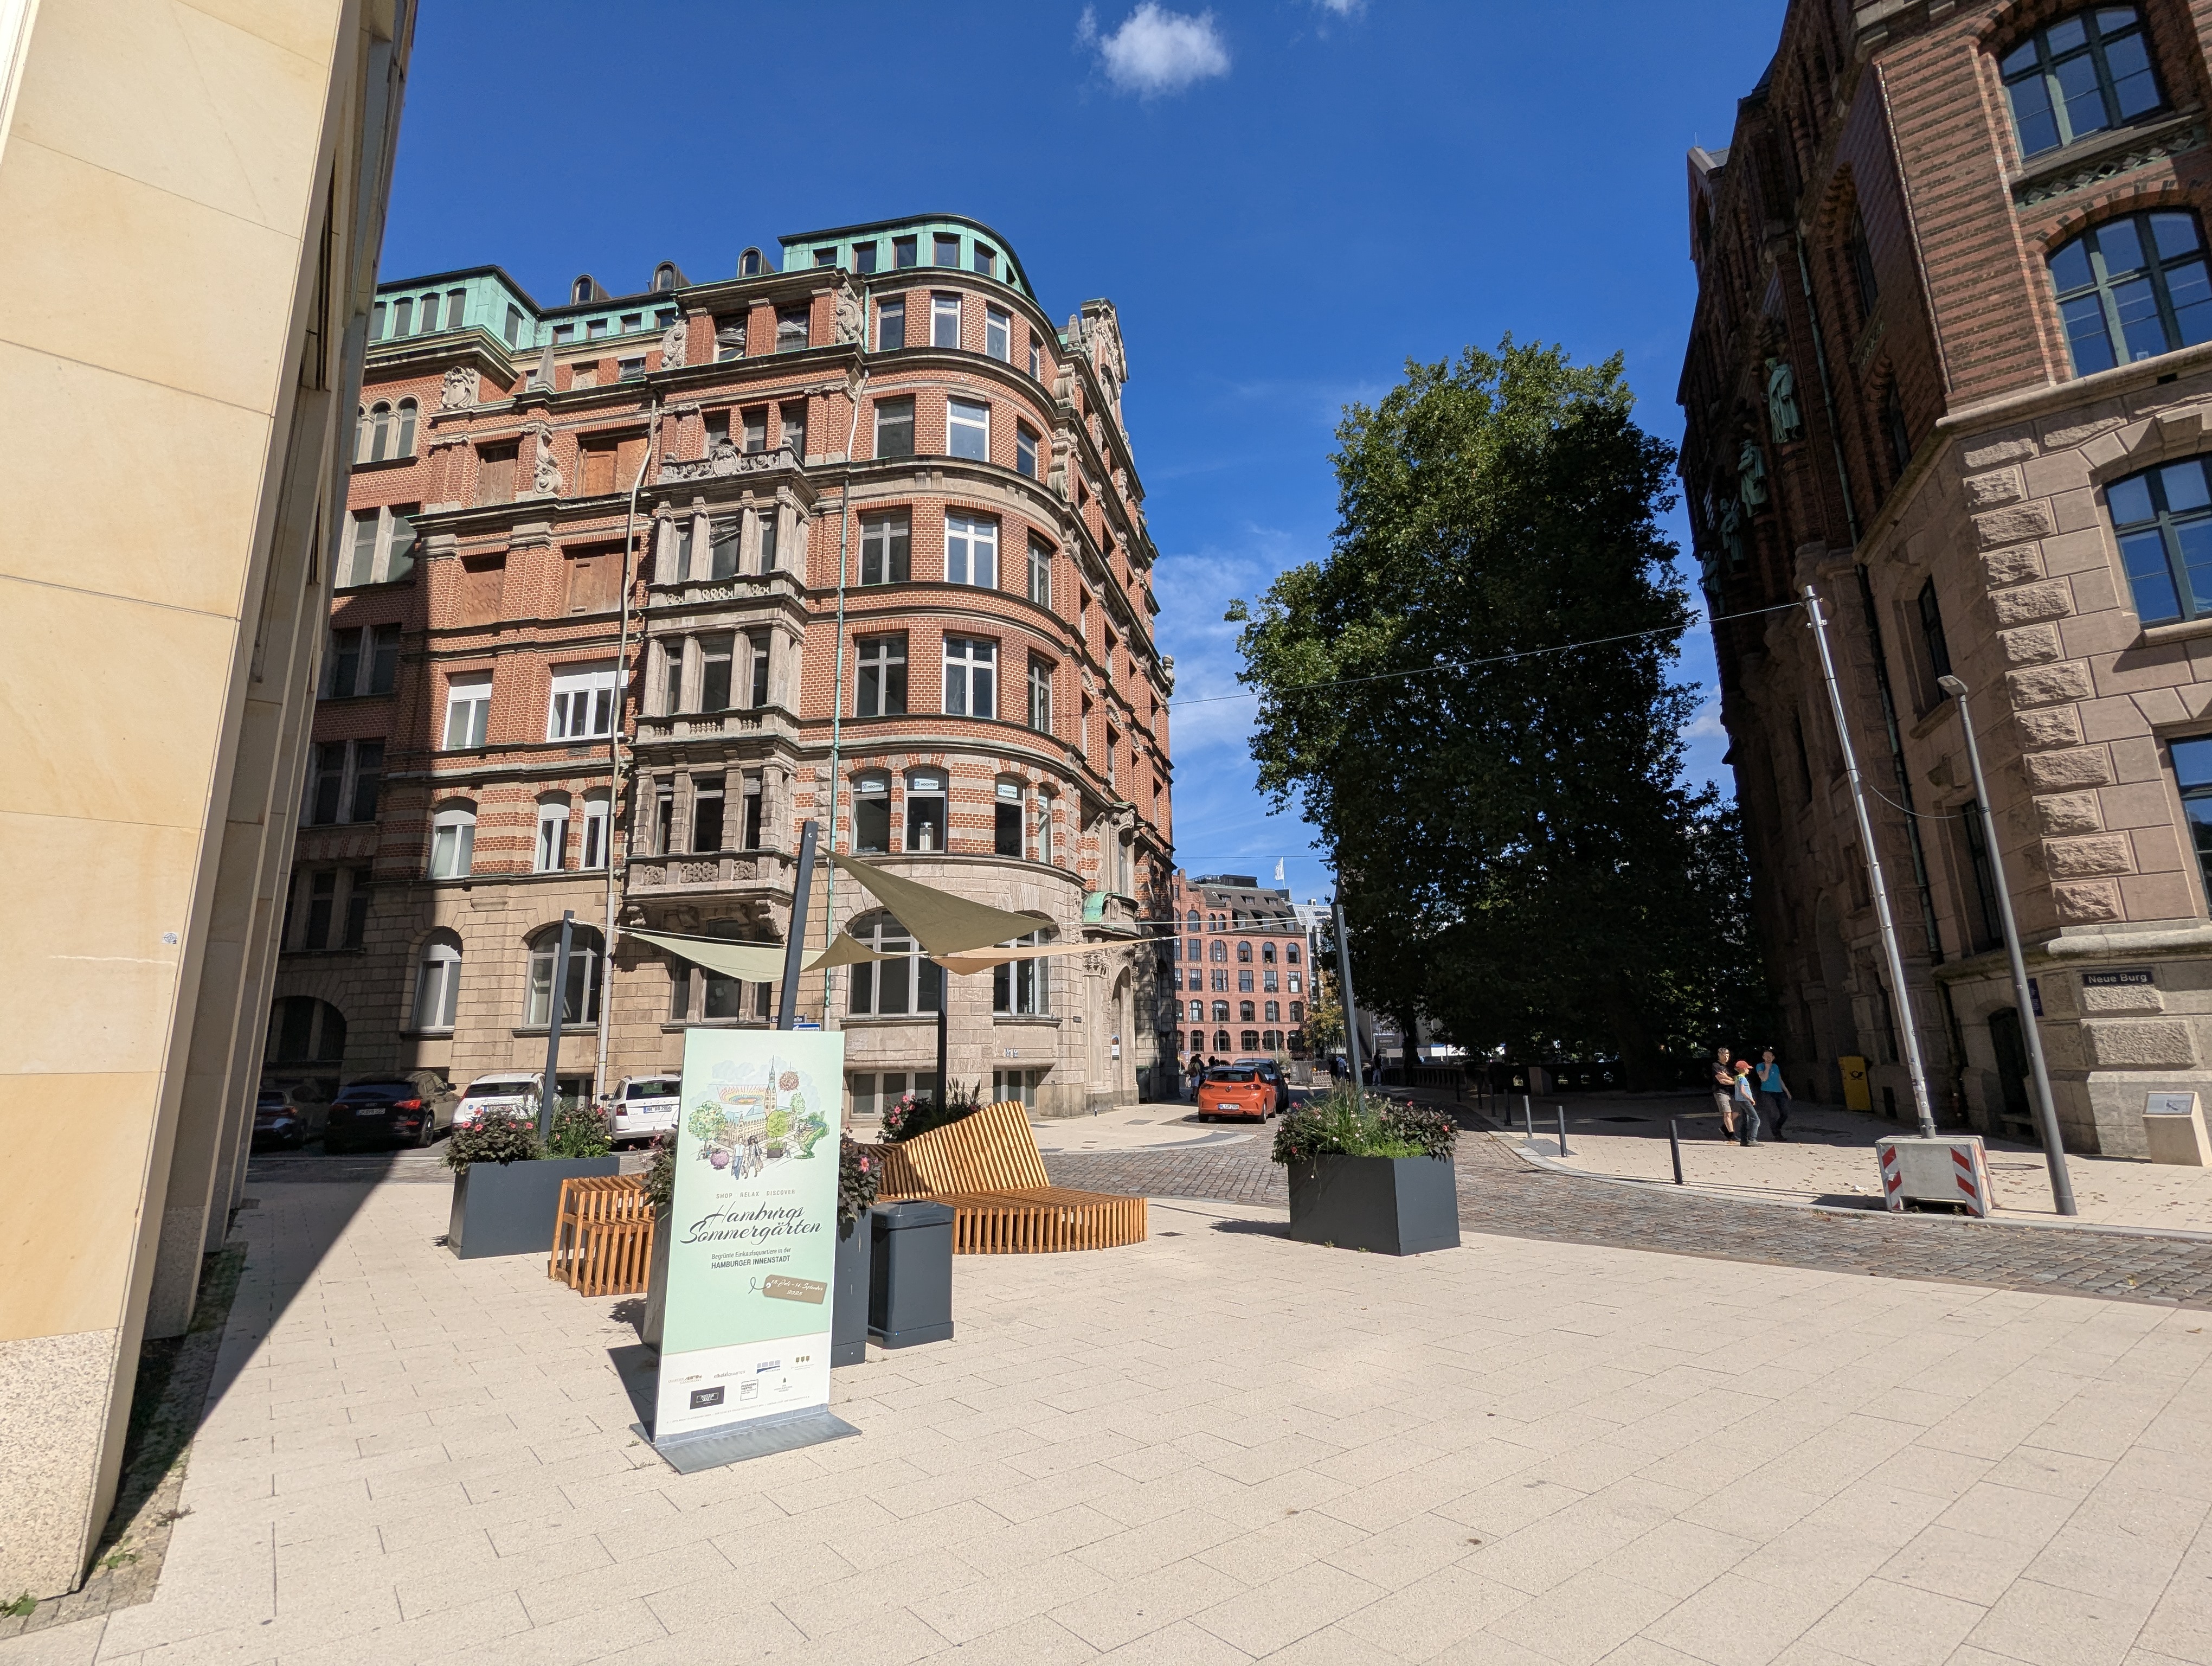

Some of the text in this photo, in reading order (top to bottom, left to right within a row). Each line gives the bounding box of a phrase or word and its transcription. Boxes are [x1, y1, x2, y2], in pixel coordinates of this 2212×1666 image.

[2120, 973, 2147, 983] Burg
[704, 1201, 806, 1228] Hamburgs
[680, 1219, 822, 1246] Sommergärten
[711, 1252, 735, 1260] Begrünte
[735, 1248, 777, 1258] Einkaufsquartiere
[711, 1255, 791, 1269] HAMBURGER INNENSTADT
